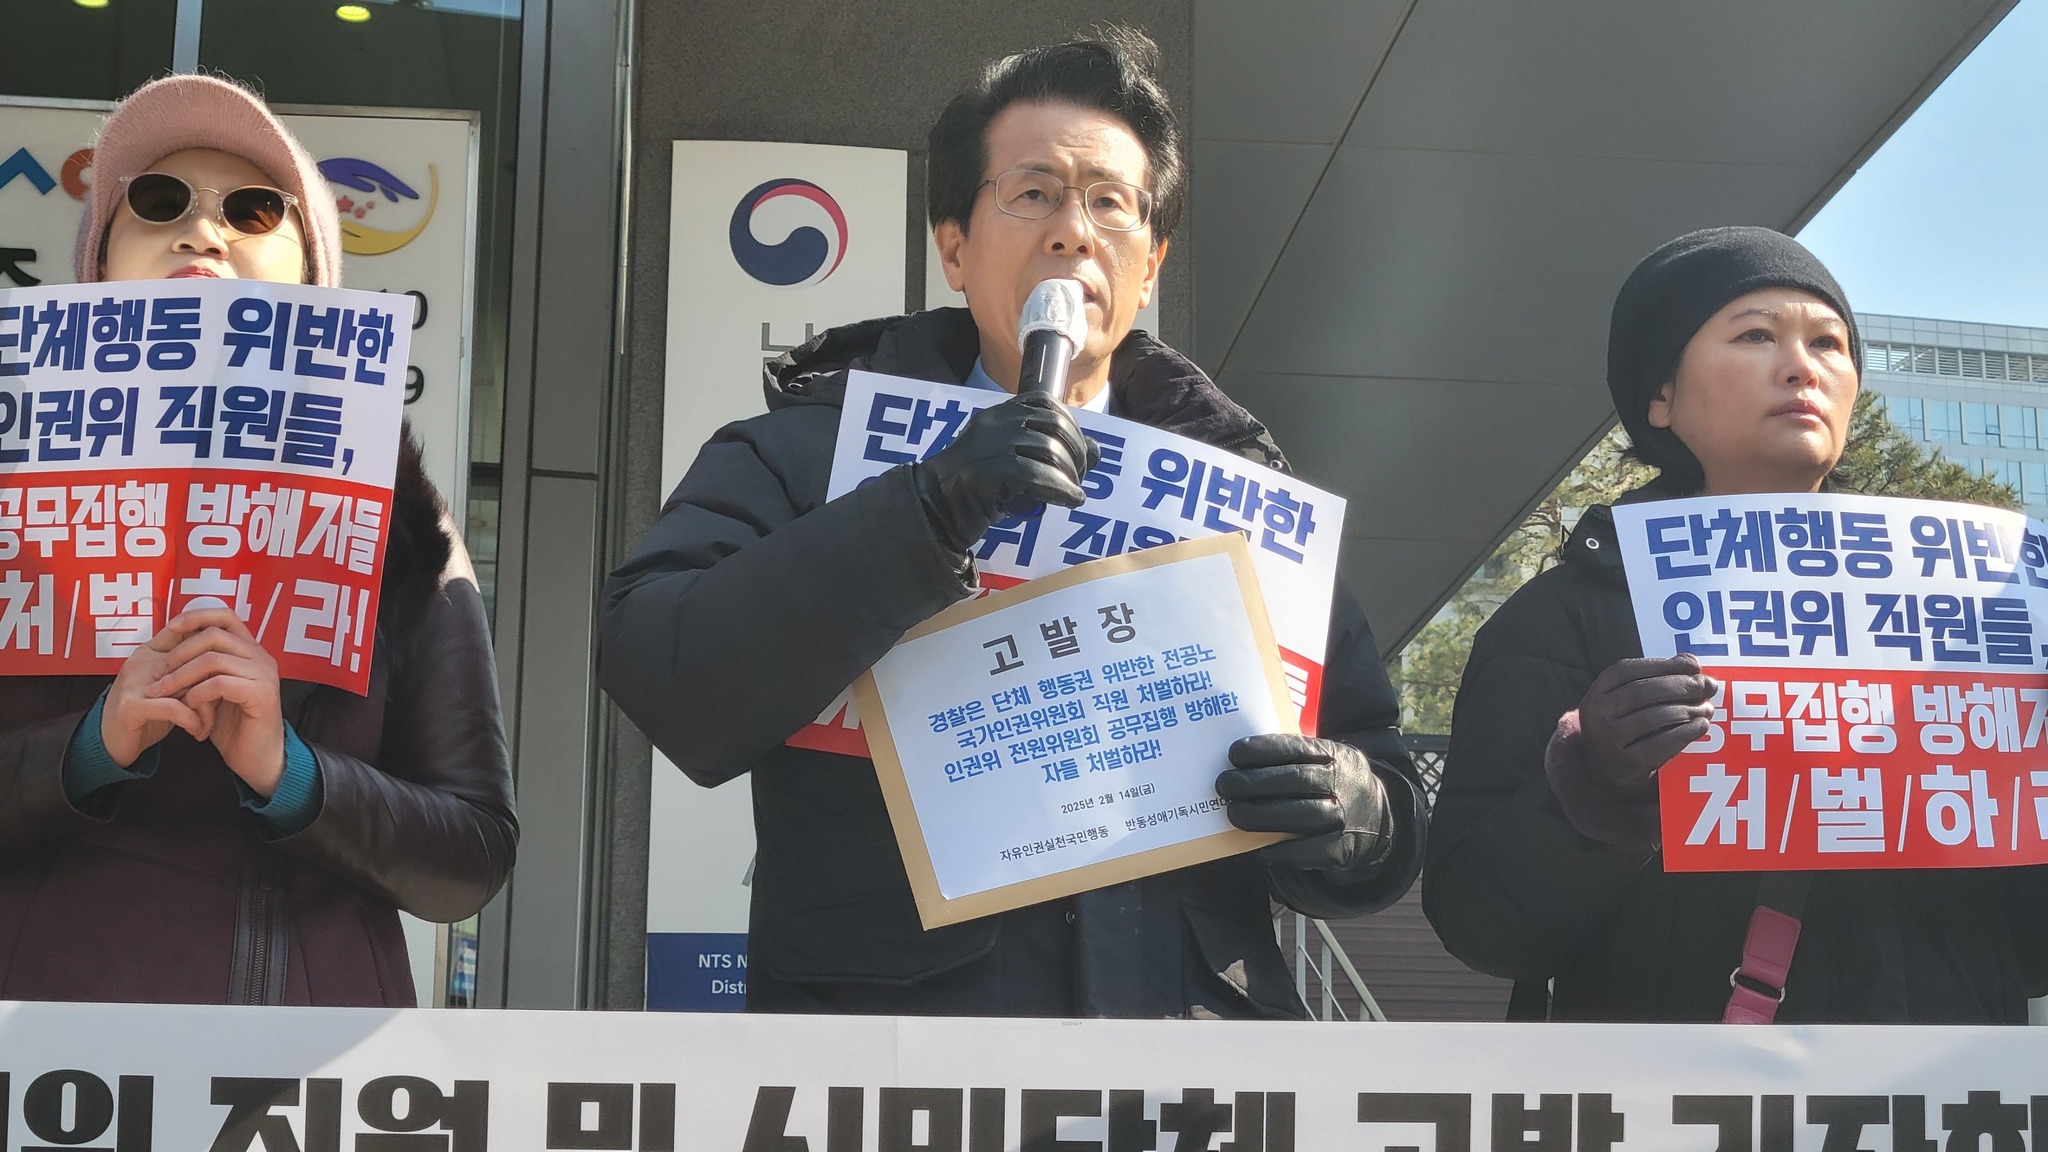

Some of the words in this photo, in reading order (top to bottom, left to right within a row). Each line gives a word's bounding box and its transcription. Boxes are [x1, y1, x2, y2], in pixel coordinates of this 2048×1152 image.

[0, 296, 201, 377] 단체행동
[223, 297, 394, 386] 위반한
[0, 386, 140, 464] 인권위
[155, 385, 355, 476] 직원들,
[186, 482, 383, 576] 방해자들
[1140, 446, 1316, 565] 위반한
[1645, 507, 1894, 581] 단체행동
[1663, 590, 1850, 658] 인권위
[928, 699, 986, 734] 경찰은
[991, 685, 1032, 714] 단체
[1037, 668, 1095, 701] 행동권
[1101, 655, 1156, 684] 위반한
[1161, 643, 1217, 671] 전공노
[956, 699, 1086, 750] 국가인권위원회
[1091, 688, 1130, 714] 직원
[1136, 670, 1214, 704] 처벌하라!
[943, 749, 1003, 784] 인권위
[1007, 724, 1101, 765] 전원위원회
[1106, 705, 1179, 741] 공무집행
[1184, 691, 1240, 722] 방해한
[1040, 758, 1081, 785] 자들
[1085, 739, 1163, 774] 처벌하라!
[1060, 797, 1095, 815] 2025년
[1098, 792, 1115, 805] 2월
[1119, 782, 1156, 801] 14일(금)
[999, 825, 1110, 863] 자유인권실천국민행동
[698, 954, 732, 968] NTS
